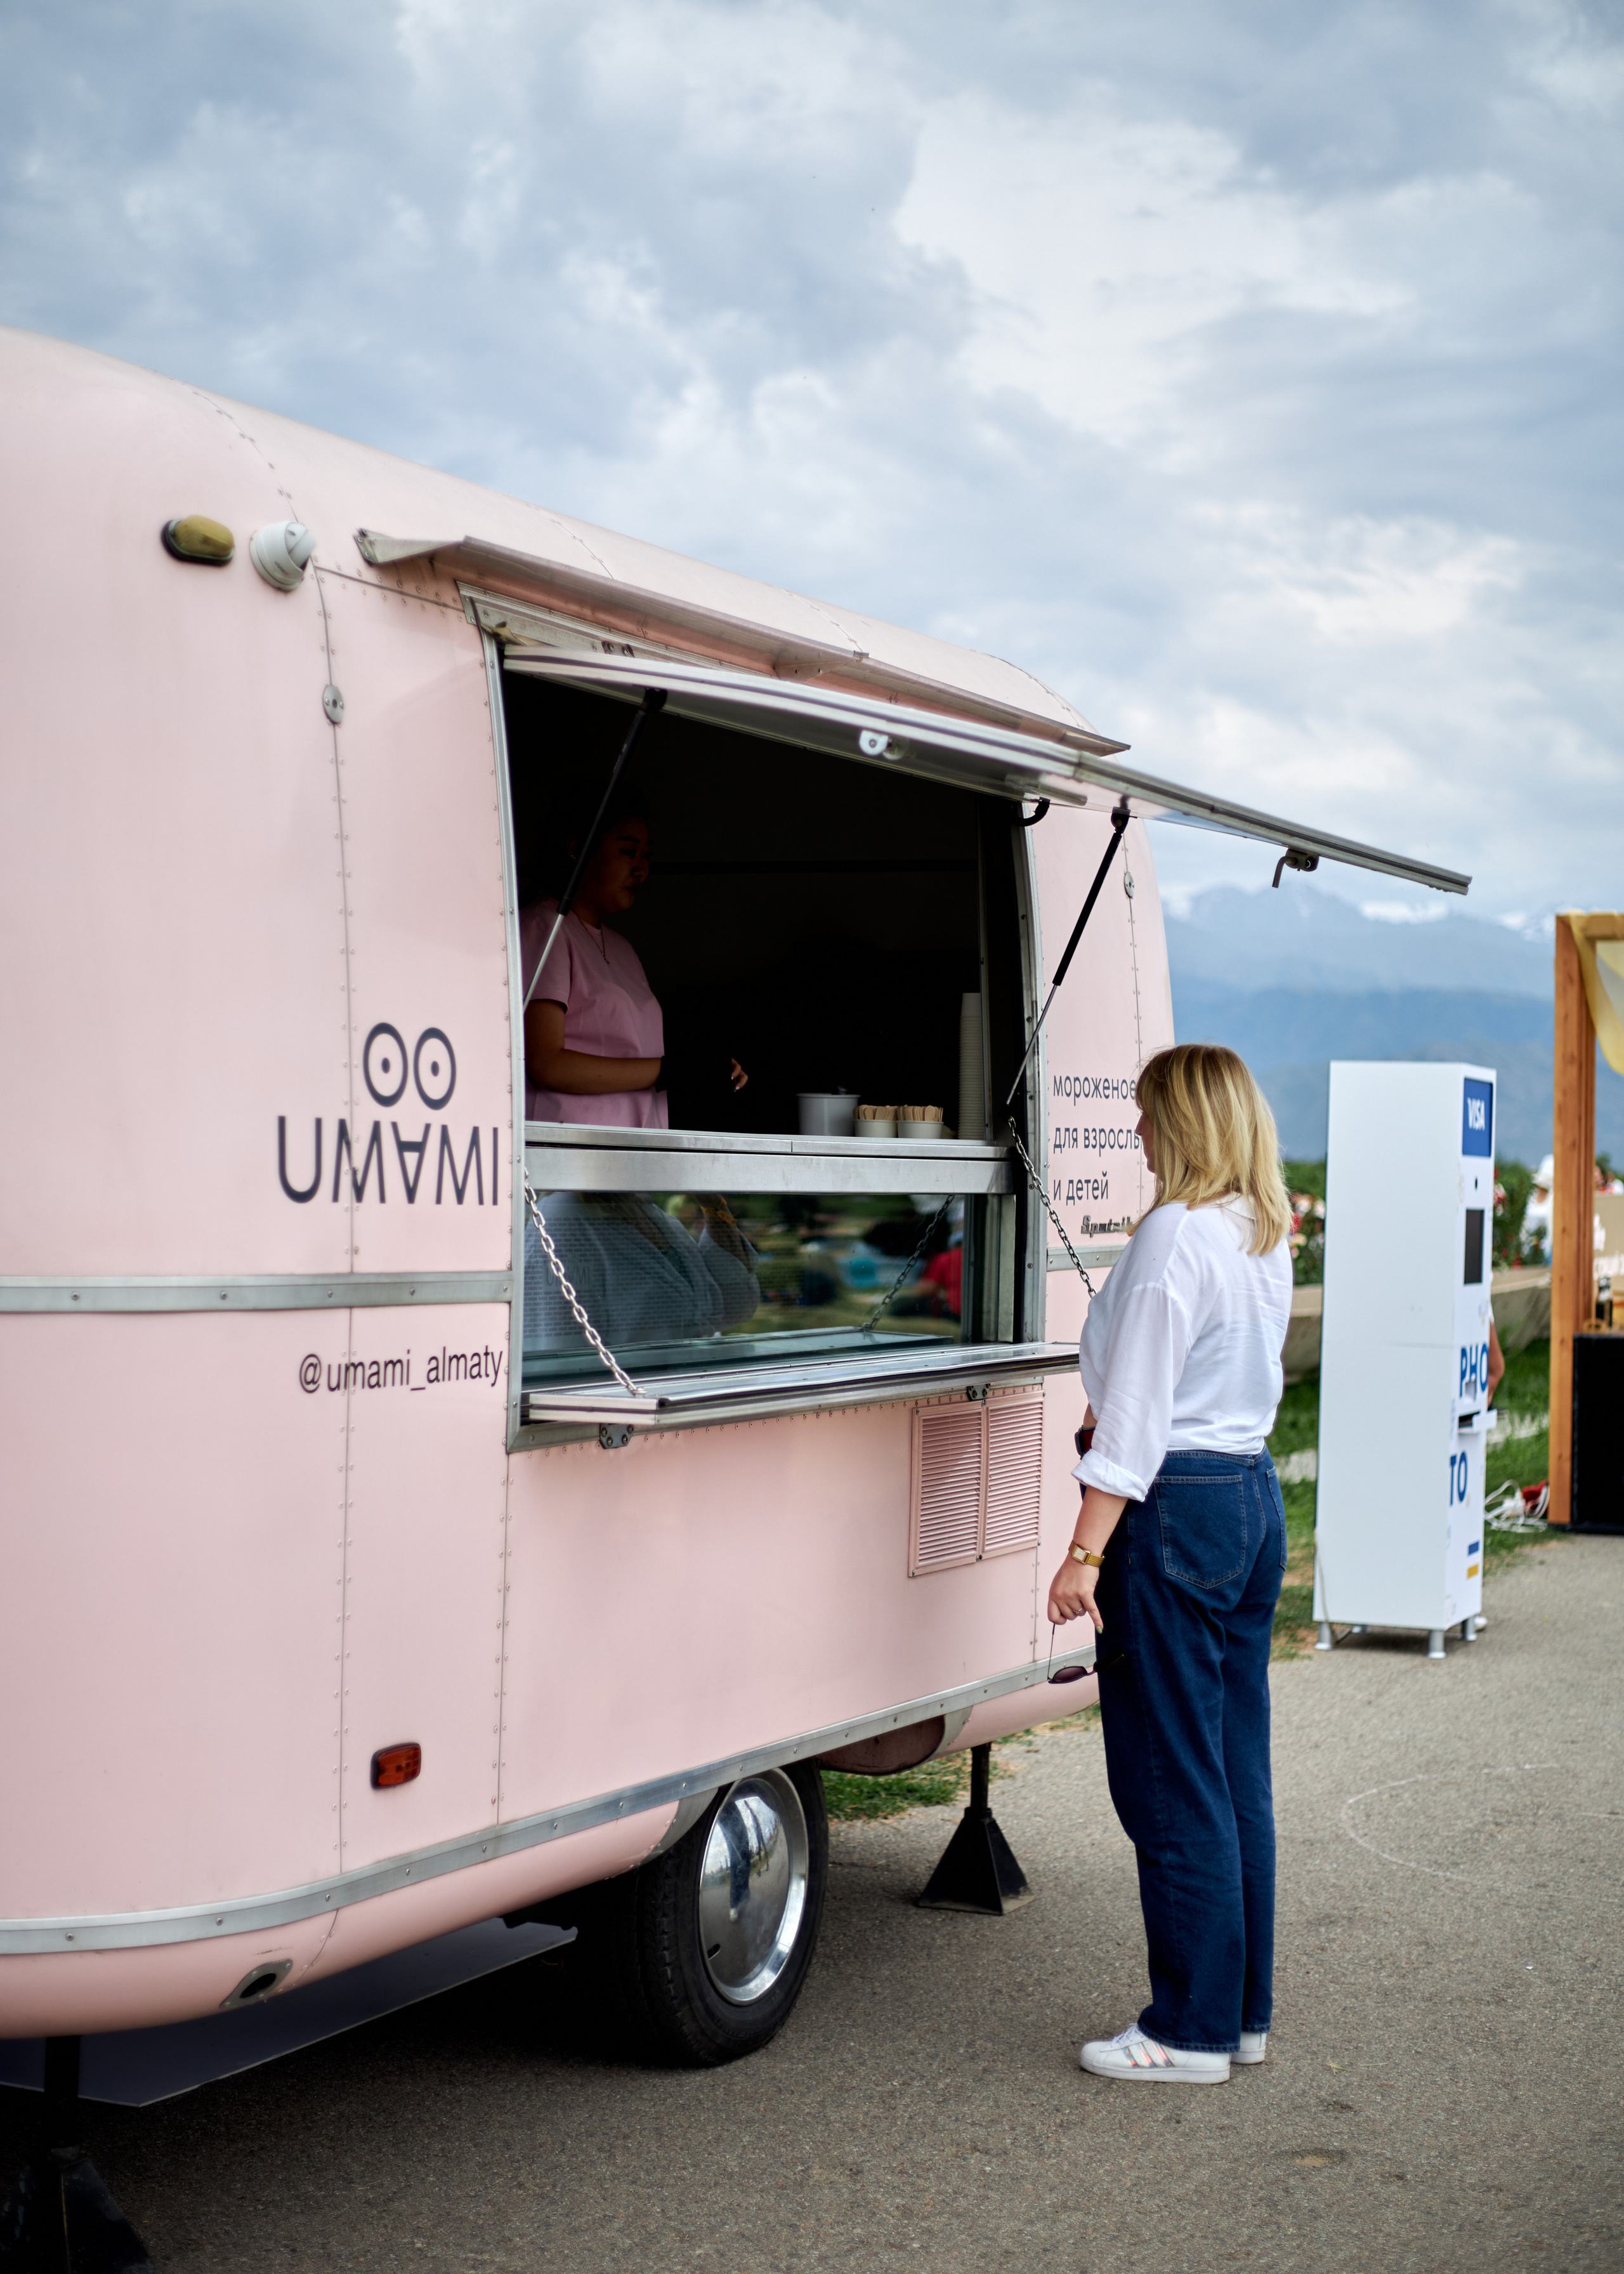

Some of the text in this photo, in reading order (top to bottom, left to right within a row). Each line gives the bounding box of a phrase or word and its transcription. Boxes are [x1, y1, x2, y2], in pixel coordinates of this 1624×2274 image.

[1053, 1075, 1136, 1106] мороженое
[1467, 1096, 1486, 1131] VISA
[277, 1115, 499, 1206] UMAMI
[1053, 1127, 1142, 1157] для взрослы
[1053, 1171, 1108, 1206] и детей
[298, 1344, 504, 1395] @umami_almaty
[1460, 1343, 1489, 1400] PHO
[1450, 1450, 1468, 1507] TO
